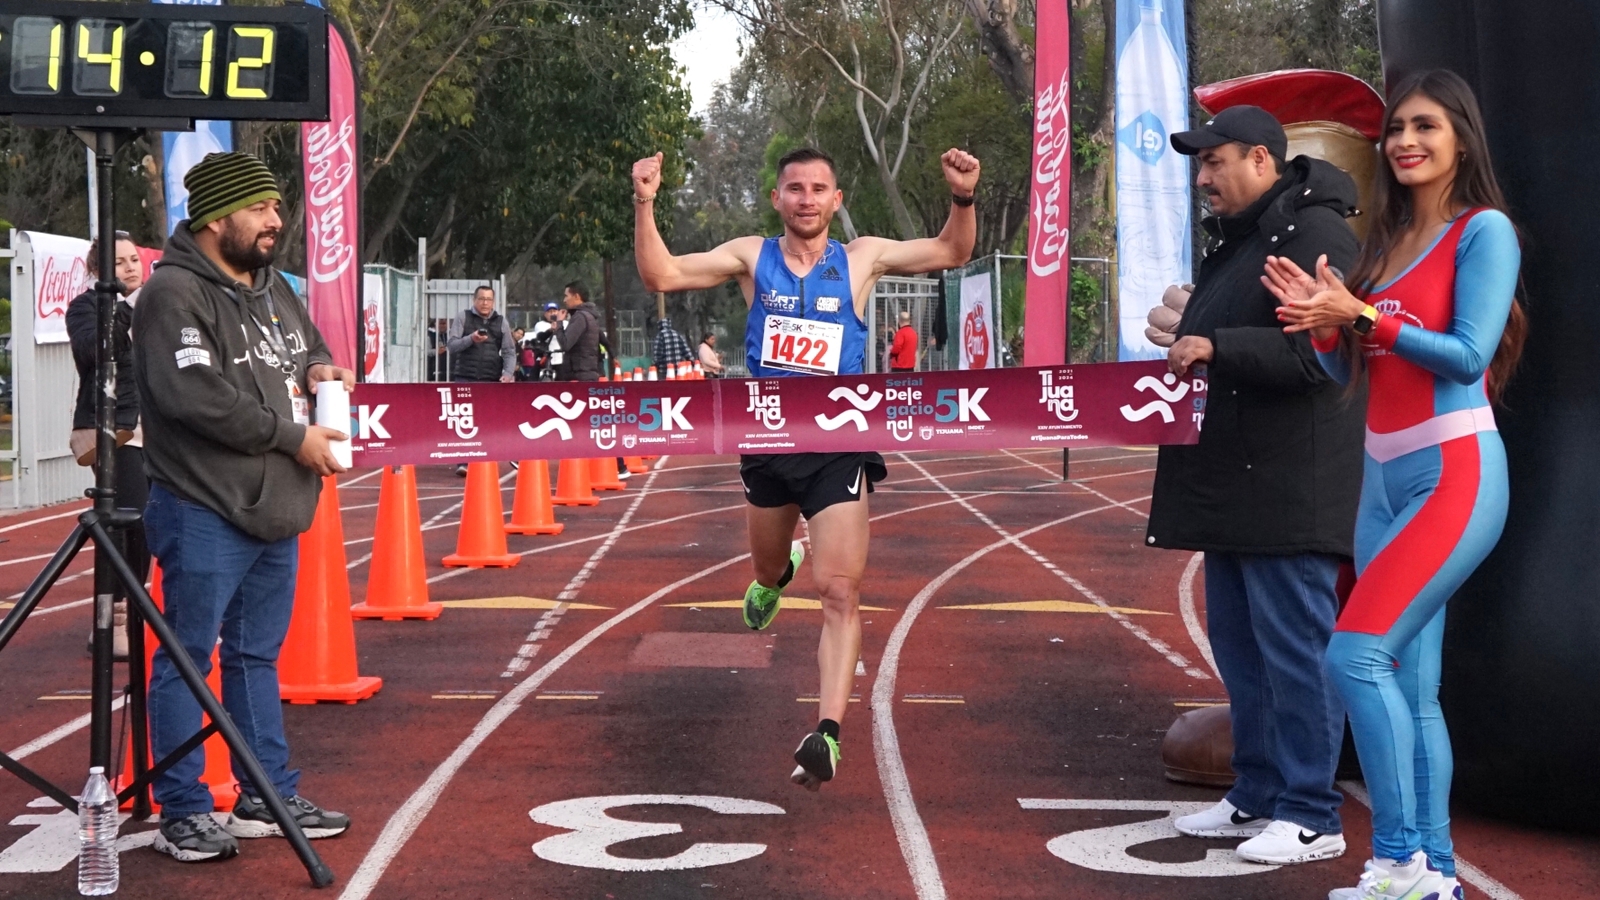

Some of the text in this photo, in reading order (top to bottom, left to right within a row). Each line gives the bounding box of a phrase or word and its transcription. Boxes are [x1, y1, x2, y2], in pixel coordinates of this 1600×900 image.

[769, 333, 829, 367] 1422
[588, 386, 625, 395] Serial
[886, 378, 923, 387] Serial
[638, 397, 694, 431] 5K
[935, 387, 991, 422] 5K
